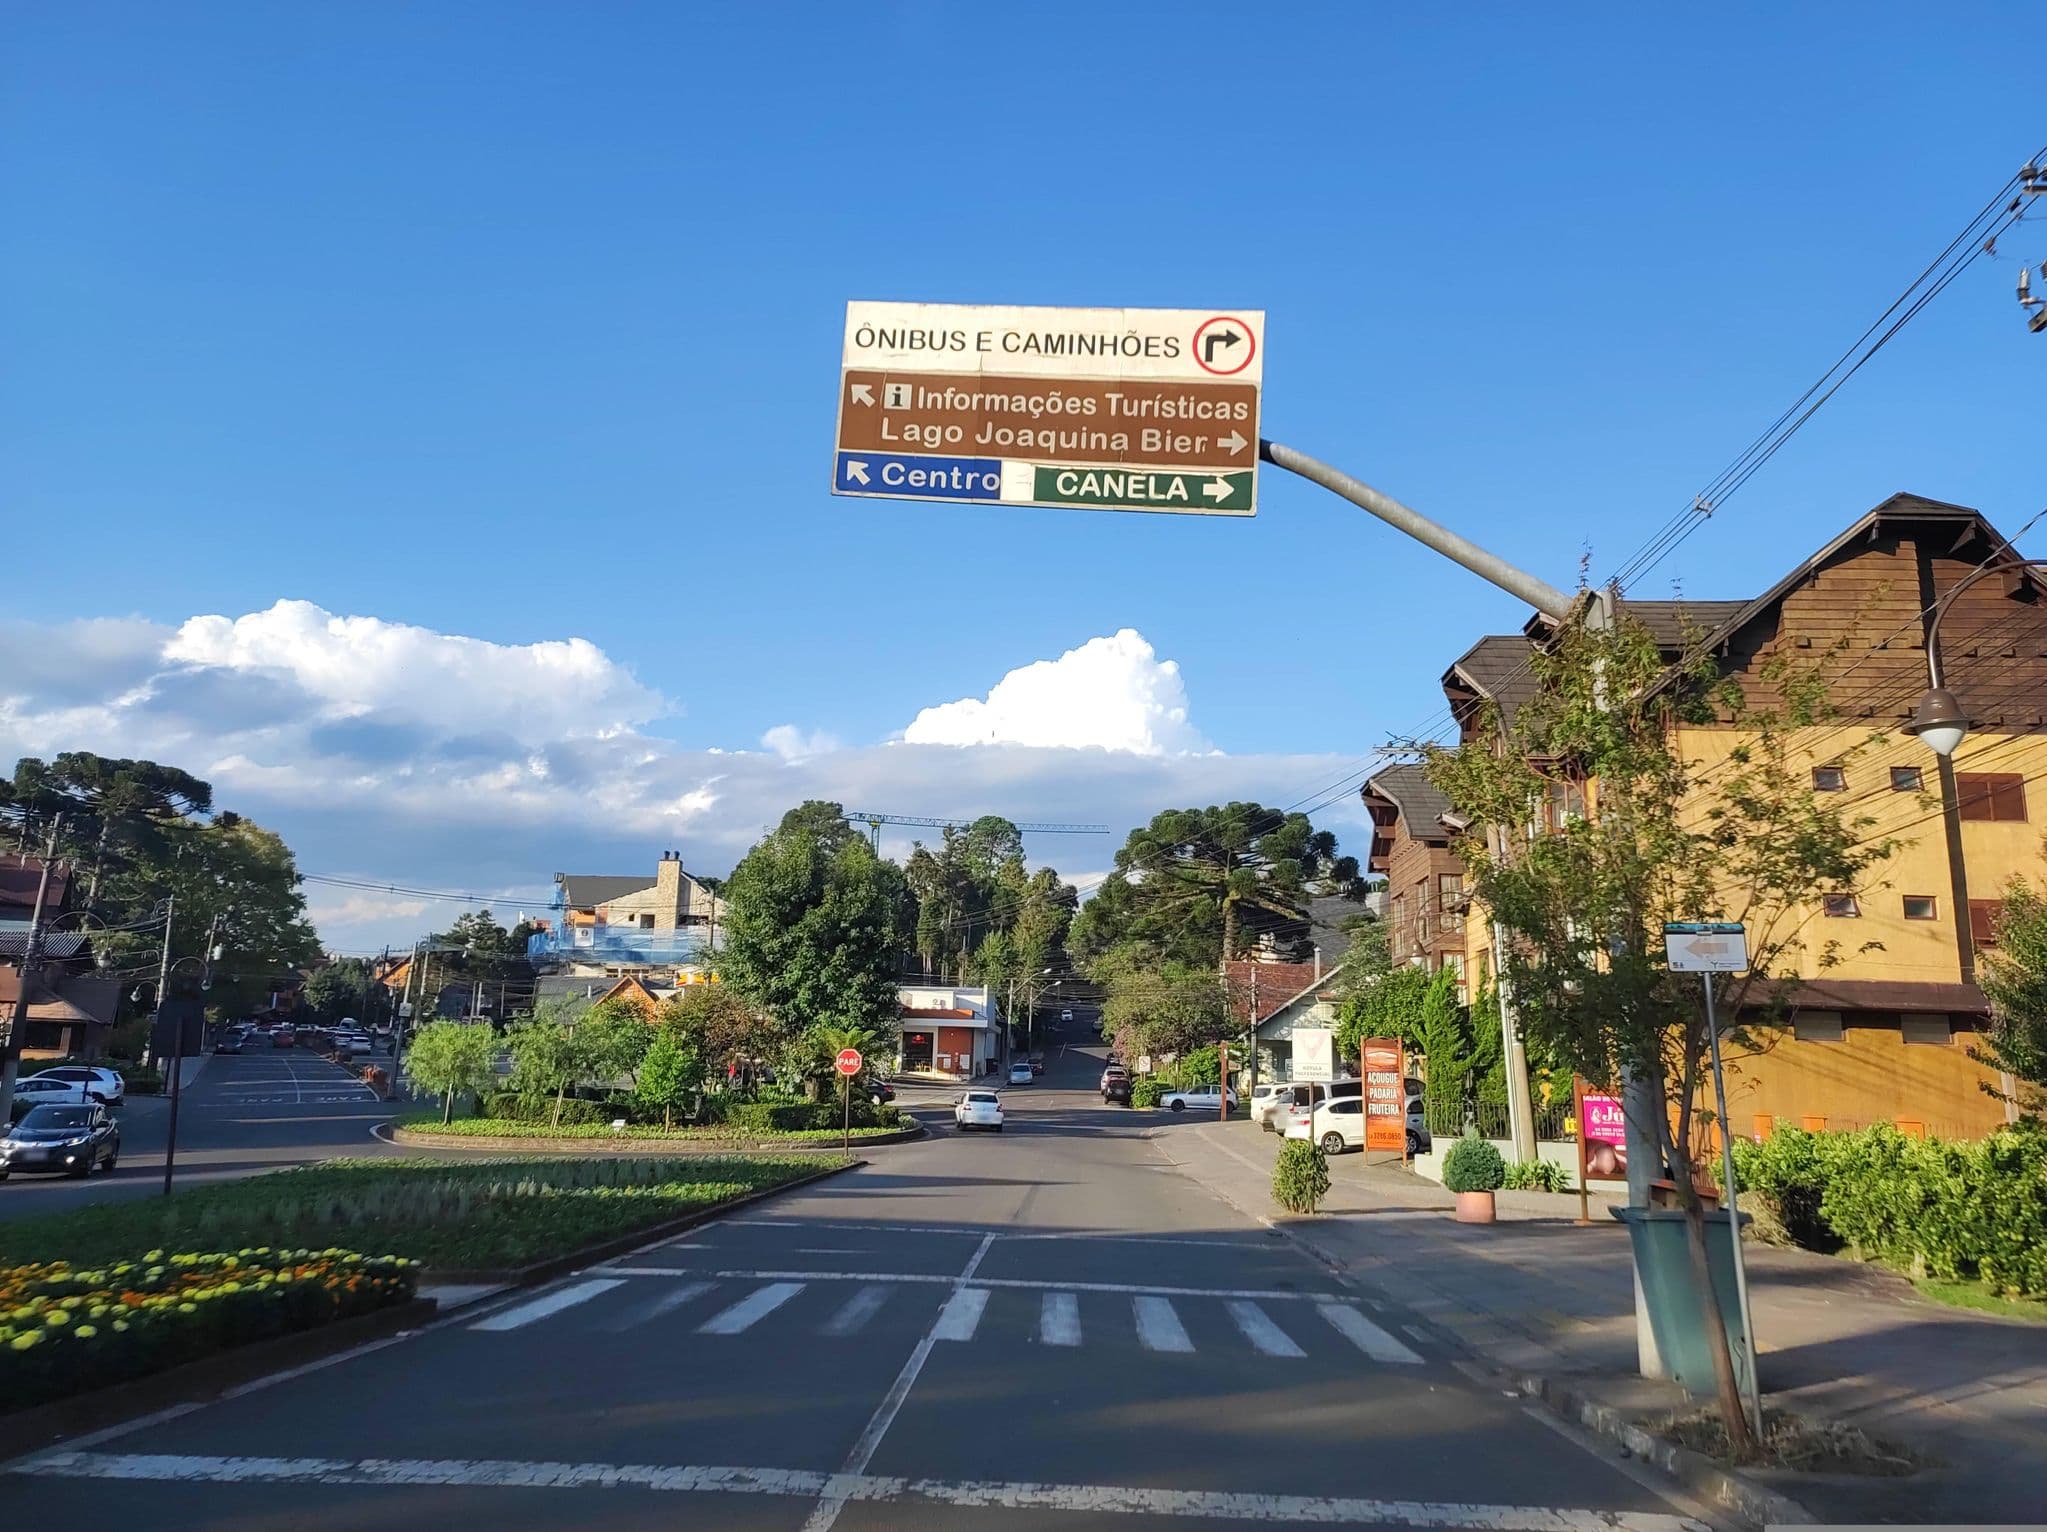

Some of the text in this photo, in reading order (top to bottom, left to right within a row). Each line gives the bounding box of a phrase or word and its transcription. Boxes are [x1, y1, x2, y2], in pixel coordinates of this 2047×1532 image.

[855, 322, 1181, 359] ÔNIBUS E CAMINHÕES
[917, 386, 1098, 419] Informações
[1104, 391, 1249, 421] Turísticas
[881, 416, 1209, 454] Lago Joaquina Bier
[881, 462, 1001, 492] Centro
[1055, 471, 1189, 501] CANELA
[838, 1057, 860, 1066] PARE
[1367, 1072, 1399, 1085] AÇOUGUE
[1369, 1087, 1398, 1100] PADARIA
[1368, 1103, 1400, 1116] FRUTEIRA
